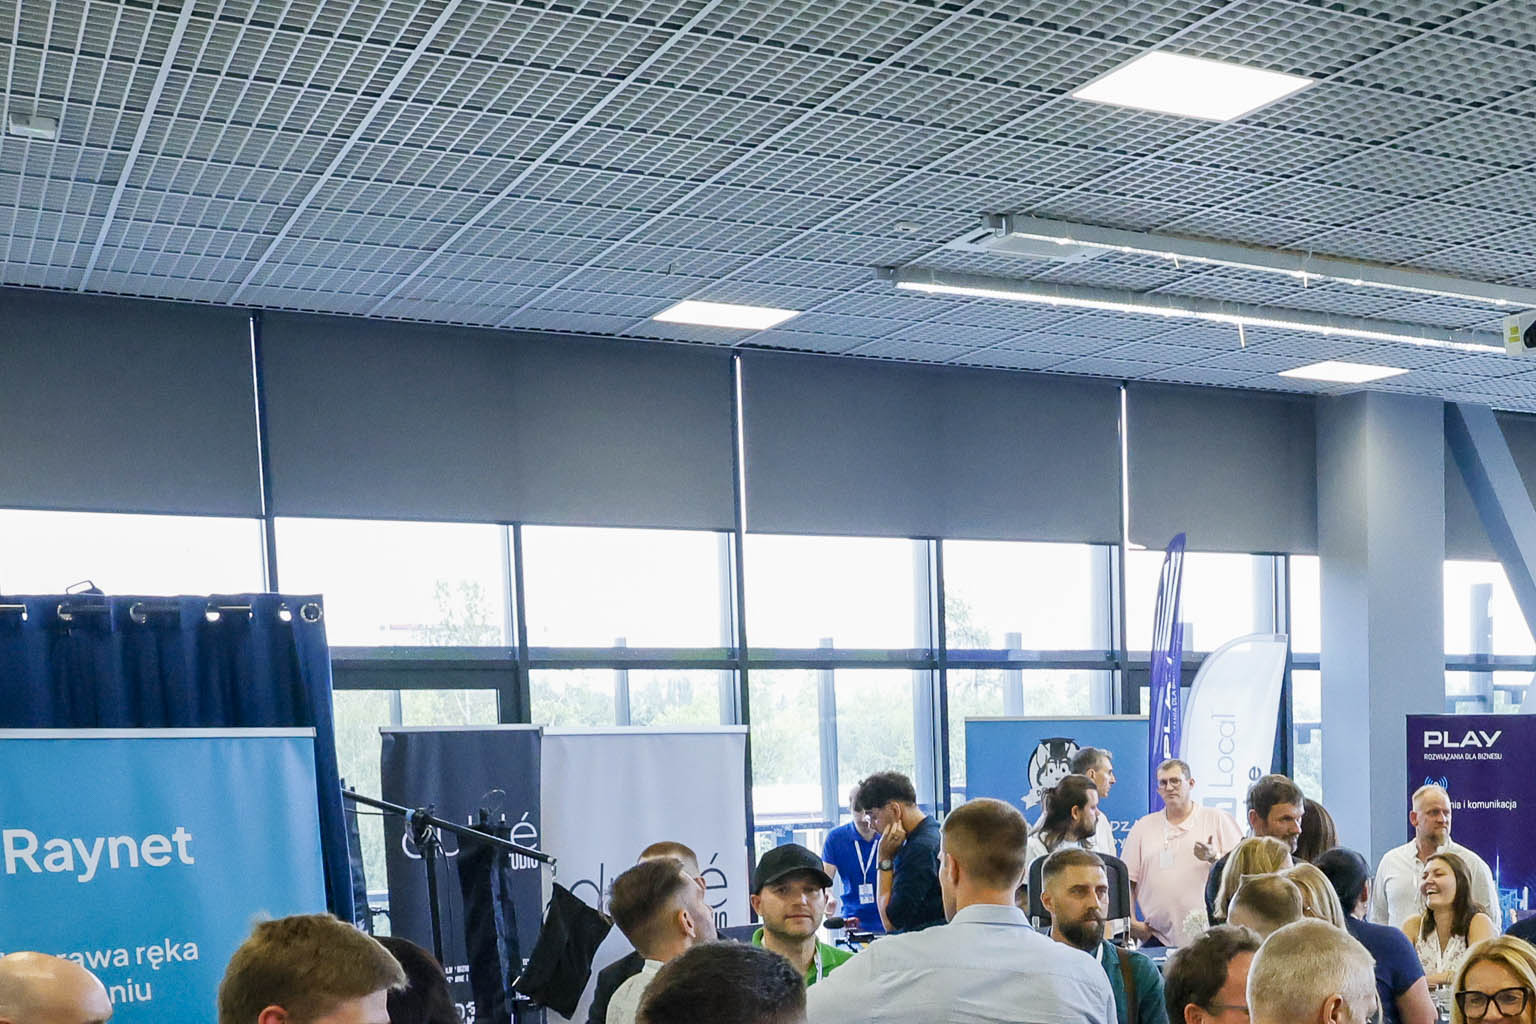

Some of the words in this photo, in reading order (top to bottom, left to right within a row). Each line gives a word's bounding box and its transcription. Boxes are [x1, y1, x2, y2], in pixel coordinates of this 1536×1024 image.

[1208, 714, 1236, 787] Local
[1424, 730, 1502, 748] PLAY
[1465, 752, 1477, 761] DLA
[1477, 752, 1503, 761] BIZNESU
[1467, 799, 1517, 812] komunikacja
[2, 826, 195, 883] Raynet
[136, 937, 199, 970] ręka
